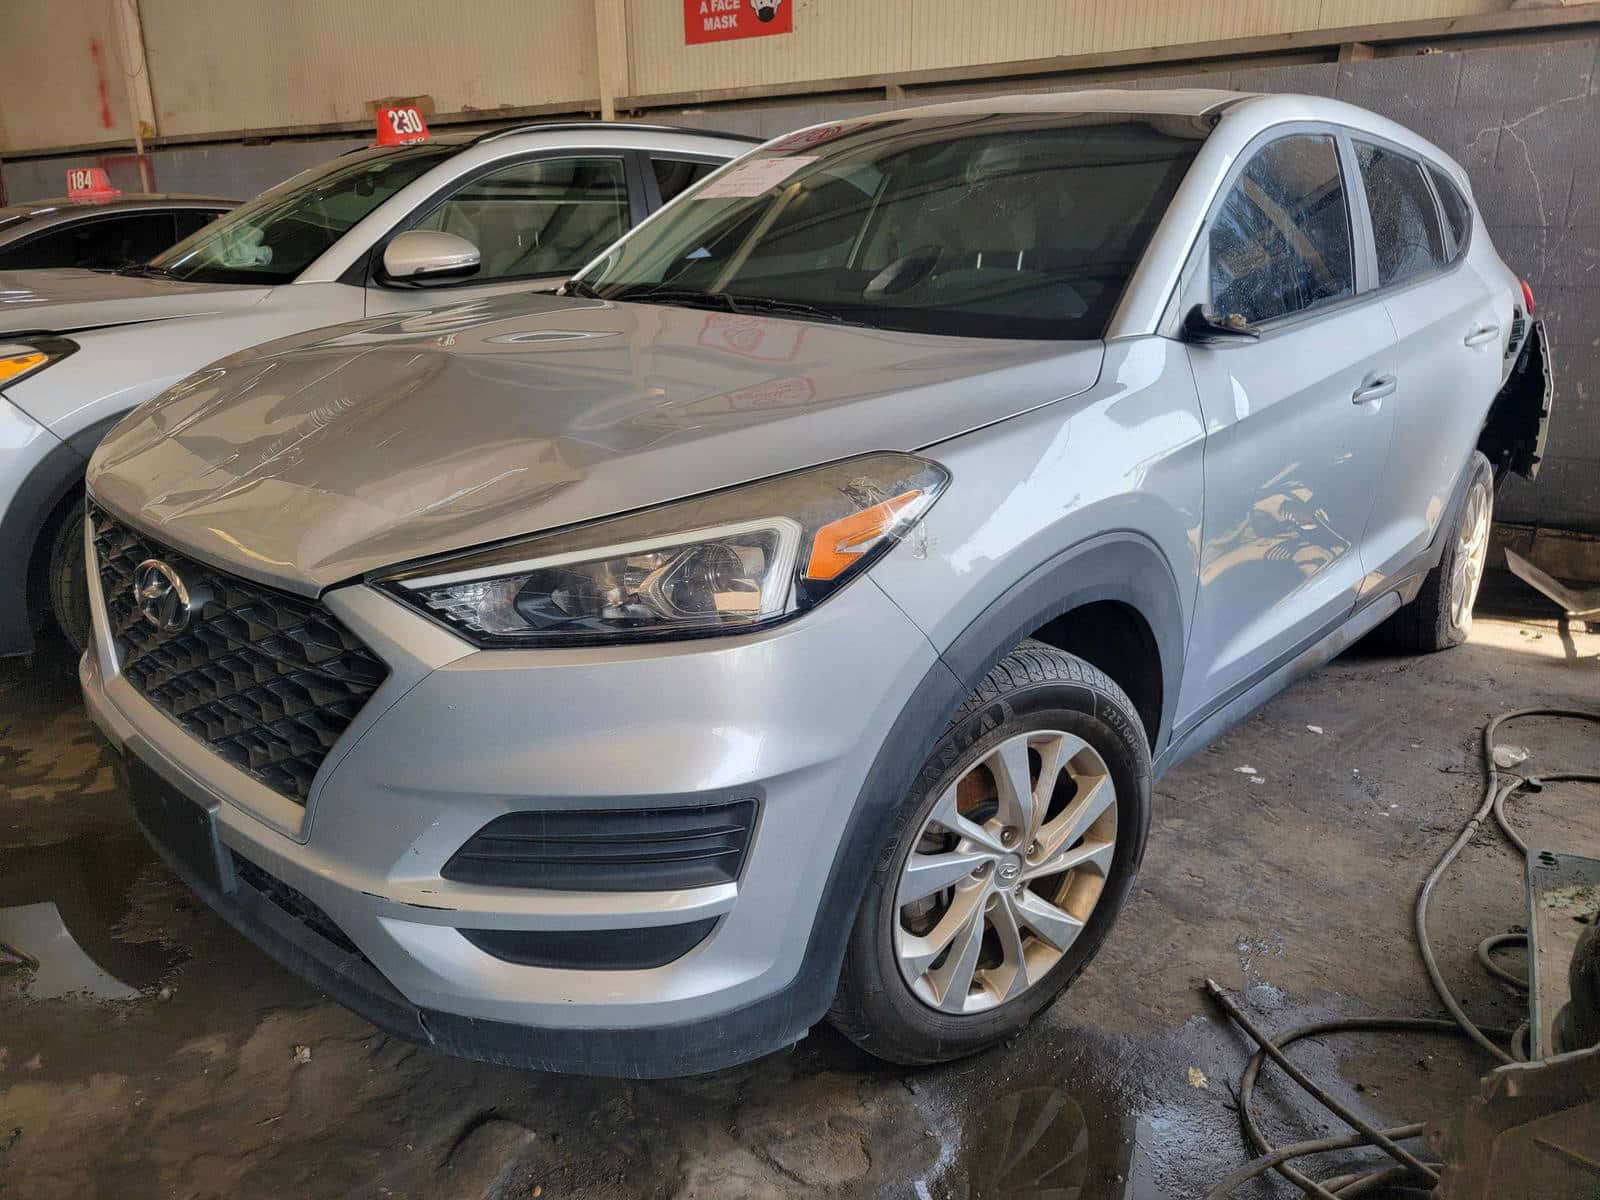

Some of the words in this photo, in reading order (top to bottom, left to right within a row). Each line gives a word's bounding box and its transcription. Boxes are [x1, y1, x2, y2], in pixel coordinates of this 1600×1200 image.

[699, 1, 708, 14] A
[711, 0, 740, 12] FACE
[703, 15, 737, 31] MASK
[388, 108, 423, 134] 230
[71, 170, 92, 190] 184
